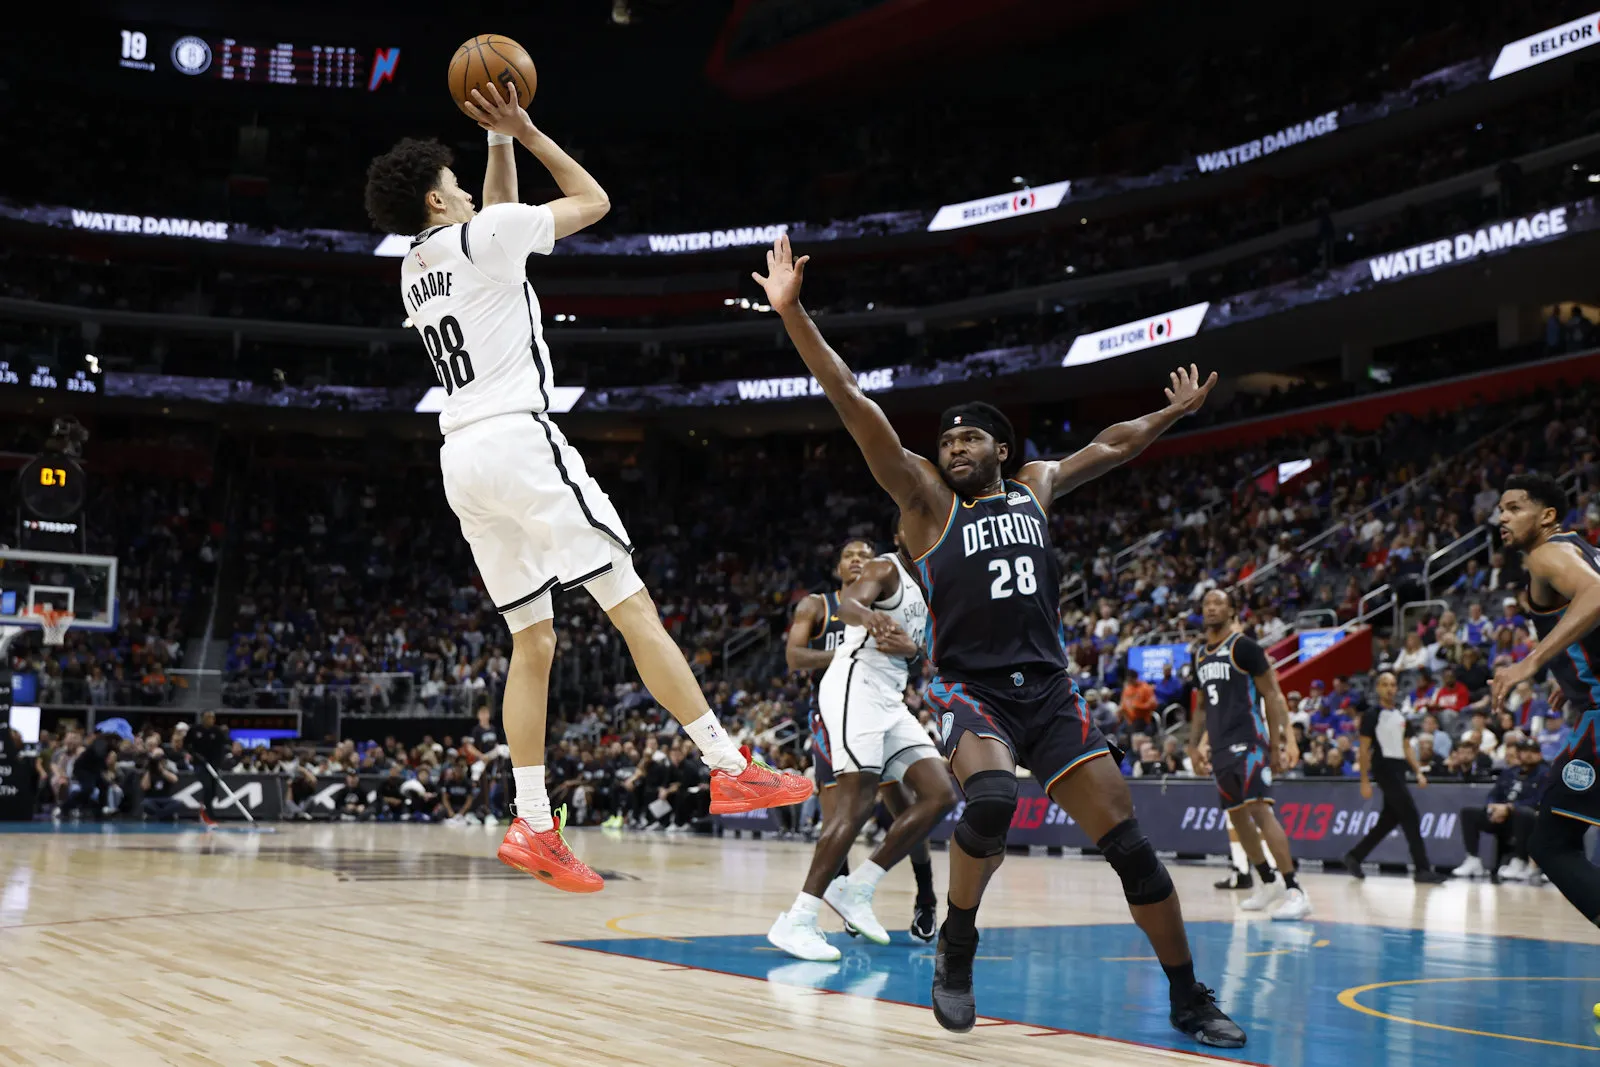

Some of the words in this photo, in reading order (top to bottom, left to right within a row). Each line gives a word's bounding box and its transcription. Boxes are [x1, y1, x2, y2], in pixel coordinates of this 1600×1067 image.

[1530, 24, 1592, 57] BELFOR
[1196, 140, 1261, 173] WATER
[1262, 110, 1339, 155] DAMAGE
[71, 209, 141, 233] WATER
[142, 216, 228, 240] DAMAGE
[963, 201, 1008, 219] BELFOR
[649, 232, 711, 252] WATER
[712, 224, 788, 248] DAMAGE
[1369, 239, 1453, 282] WATER
[1454, 207, 1568, 260] DAMAGE
[407, 271, 452, 312] TRAORE
[424, 315, 475, 397] 88
[1098, 328, 1145, 352] BELFOR
[737, 377, 808, 400] WATER
[809, 368, 893, 396] DAGE
[41, 467, 66, 487] 0.7
[962, 512, 1045, 558] DETROIT
[988, 555, 1037, 600] 28
[1207, 684, 1219, 705] 5
[1279, 803, 1335, 840] 313
